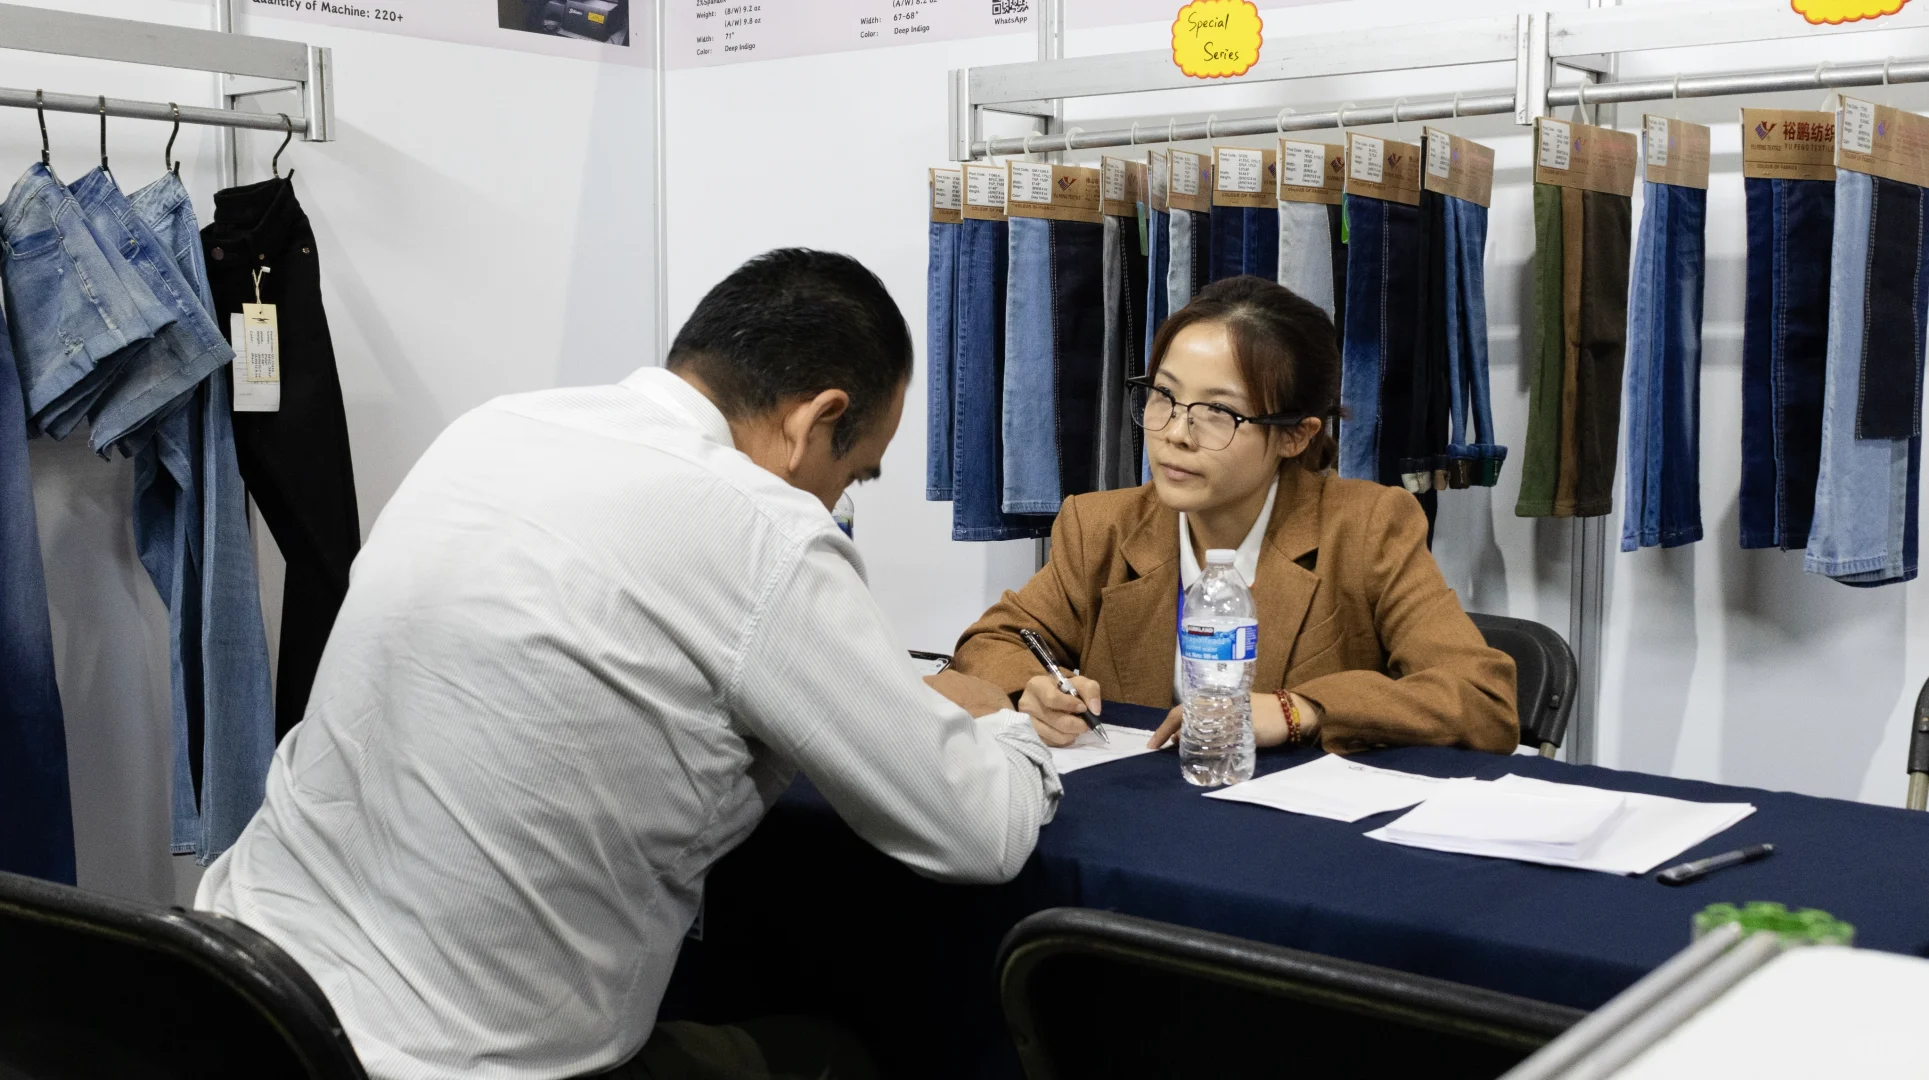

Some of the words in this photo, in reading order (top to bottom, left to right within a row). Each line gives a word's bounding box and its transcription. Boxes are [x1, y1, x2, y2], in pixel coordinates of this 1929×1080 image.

[305, 1, 317, 10] of
[321, 3, 370, 18] Machine:
[375, 9, 403, 22] 220+
[696, 11, 717, 19] Weight:
[860, 17, 881, 25] Width:
[893, 11, 918, 21] 67-68"
[994, 16, 1027, 25] WhatsApp
[894, 27, 909, 35] Deep
[911, 25, 930, 33] Indigo
[1188, 12, 1229, 38] Special
[696, 35, 714, 43] Width:
[739, 43, 756, 51] Indigo
[1204, 41, 1239, 61] Series
